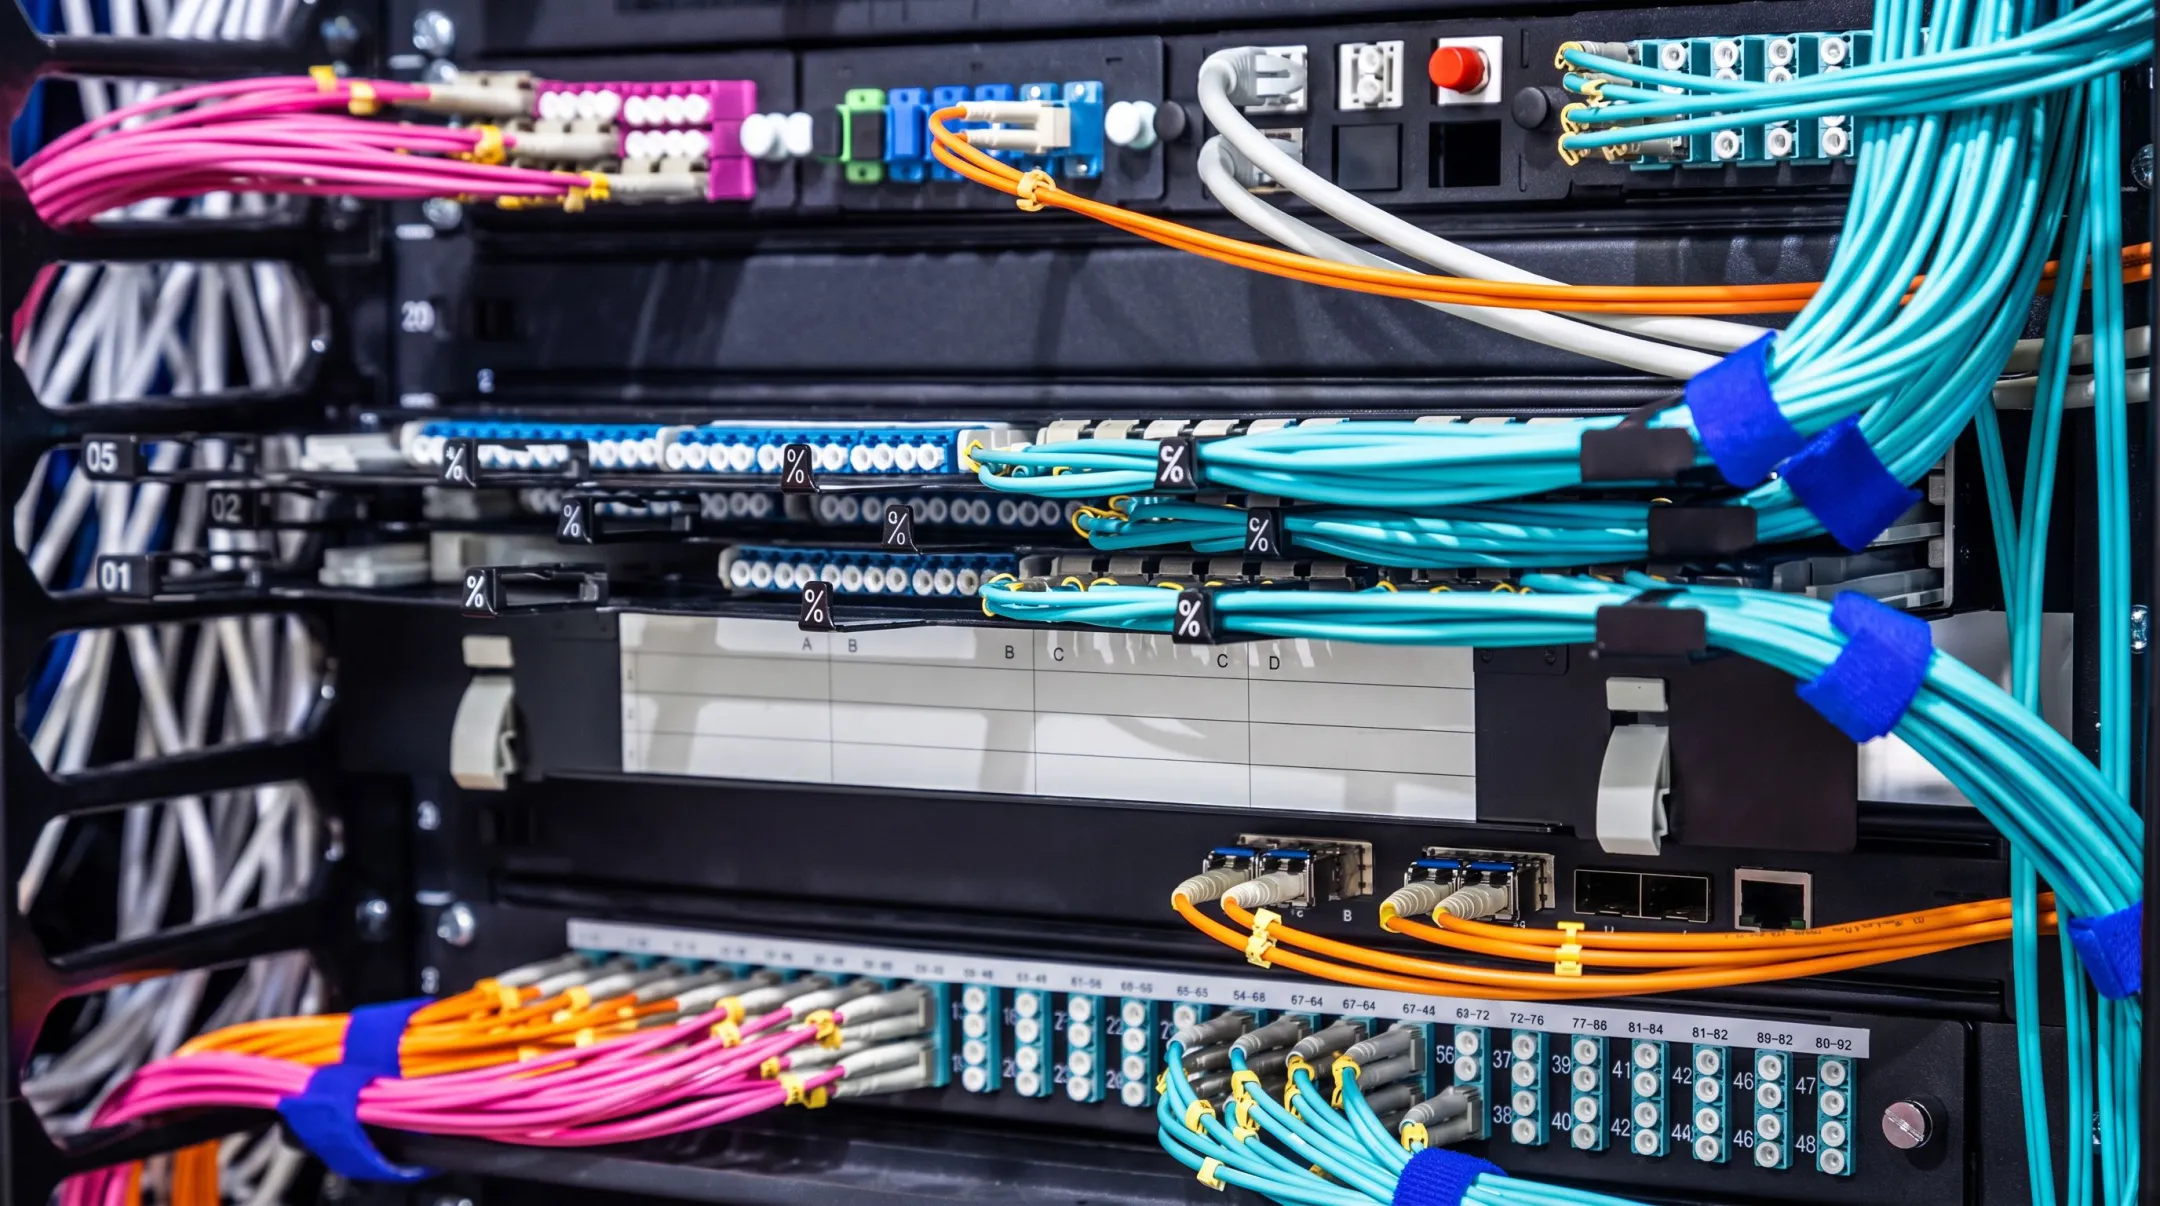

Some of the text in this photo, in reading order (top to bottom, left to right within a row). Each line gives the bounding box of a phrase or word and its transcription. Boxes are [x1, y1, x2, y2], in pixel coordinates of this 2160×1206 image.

[86, 441, 118, 474] 05
[211, 494, 241, 523] 02
[101, 561, 131, 592] 01
[802, 636, 812, 651] A
[848, 638, 858, 653] B
[1005, 645, 1015, 659] B
[1053, 647, 1064, 662] C
[1217, 653, 1228, 668] C
[1269, 655, 1280, 670] D
[1343, 909, 1353, 922] B
[1291, 995, 1323, 1007] 67-64
[1342, 999, 1376, 1011] 67-64
[1402, 1003, 1436, 1016] 67-44
[1456, 1008, 1490, 1020] 63-72
[1510, 1012, 1545, 1026] 72-76
[1572, 1017, 1607, 1031] 77-86
[1628, 1022, 1663, 1035] 81-84
[1692, 1027, 1728, 1040] 81-82
[1757, 1032, 1793, 1045] 89-82
[1815, 1037, 1852, 1050] 80-92
[1436, 1045, 1455, 1064] 56
[1493, 1050, 1511, 1068] 37
[1552, 1055, 1571, 1074] 39
[1612, 1060, 1631, 1079] 41
[1672, 1067, 1692, 1085] 42
[1733, 1072, 1754, 1090] 46
[1795, 1077, 1816, 1095] 47
[1493, 1105, 1512, 1124] 38
[1552, 1112, 1571, 1131] 40
[1611, 1119, 1630, 1137] 42
[1733, 1130, 1754, 1148] 46
[1795, 1135, 1816, 1153] 48
